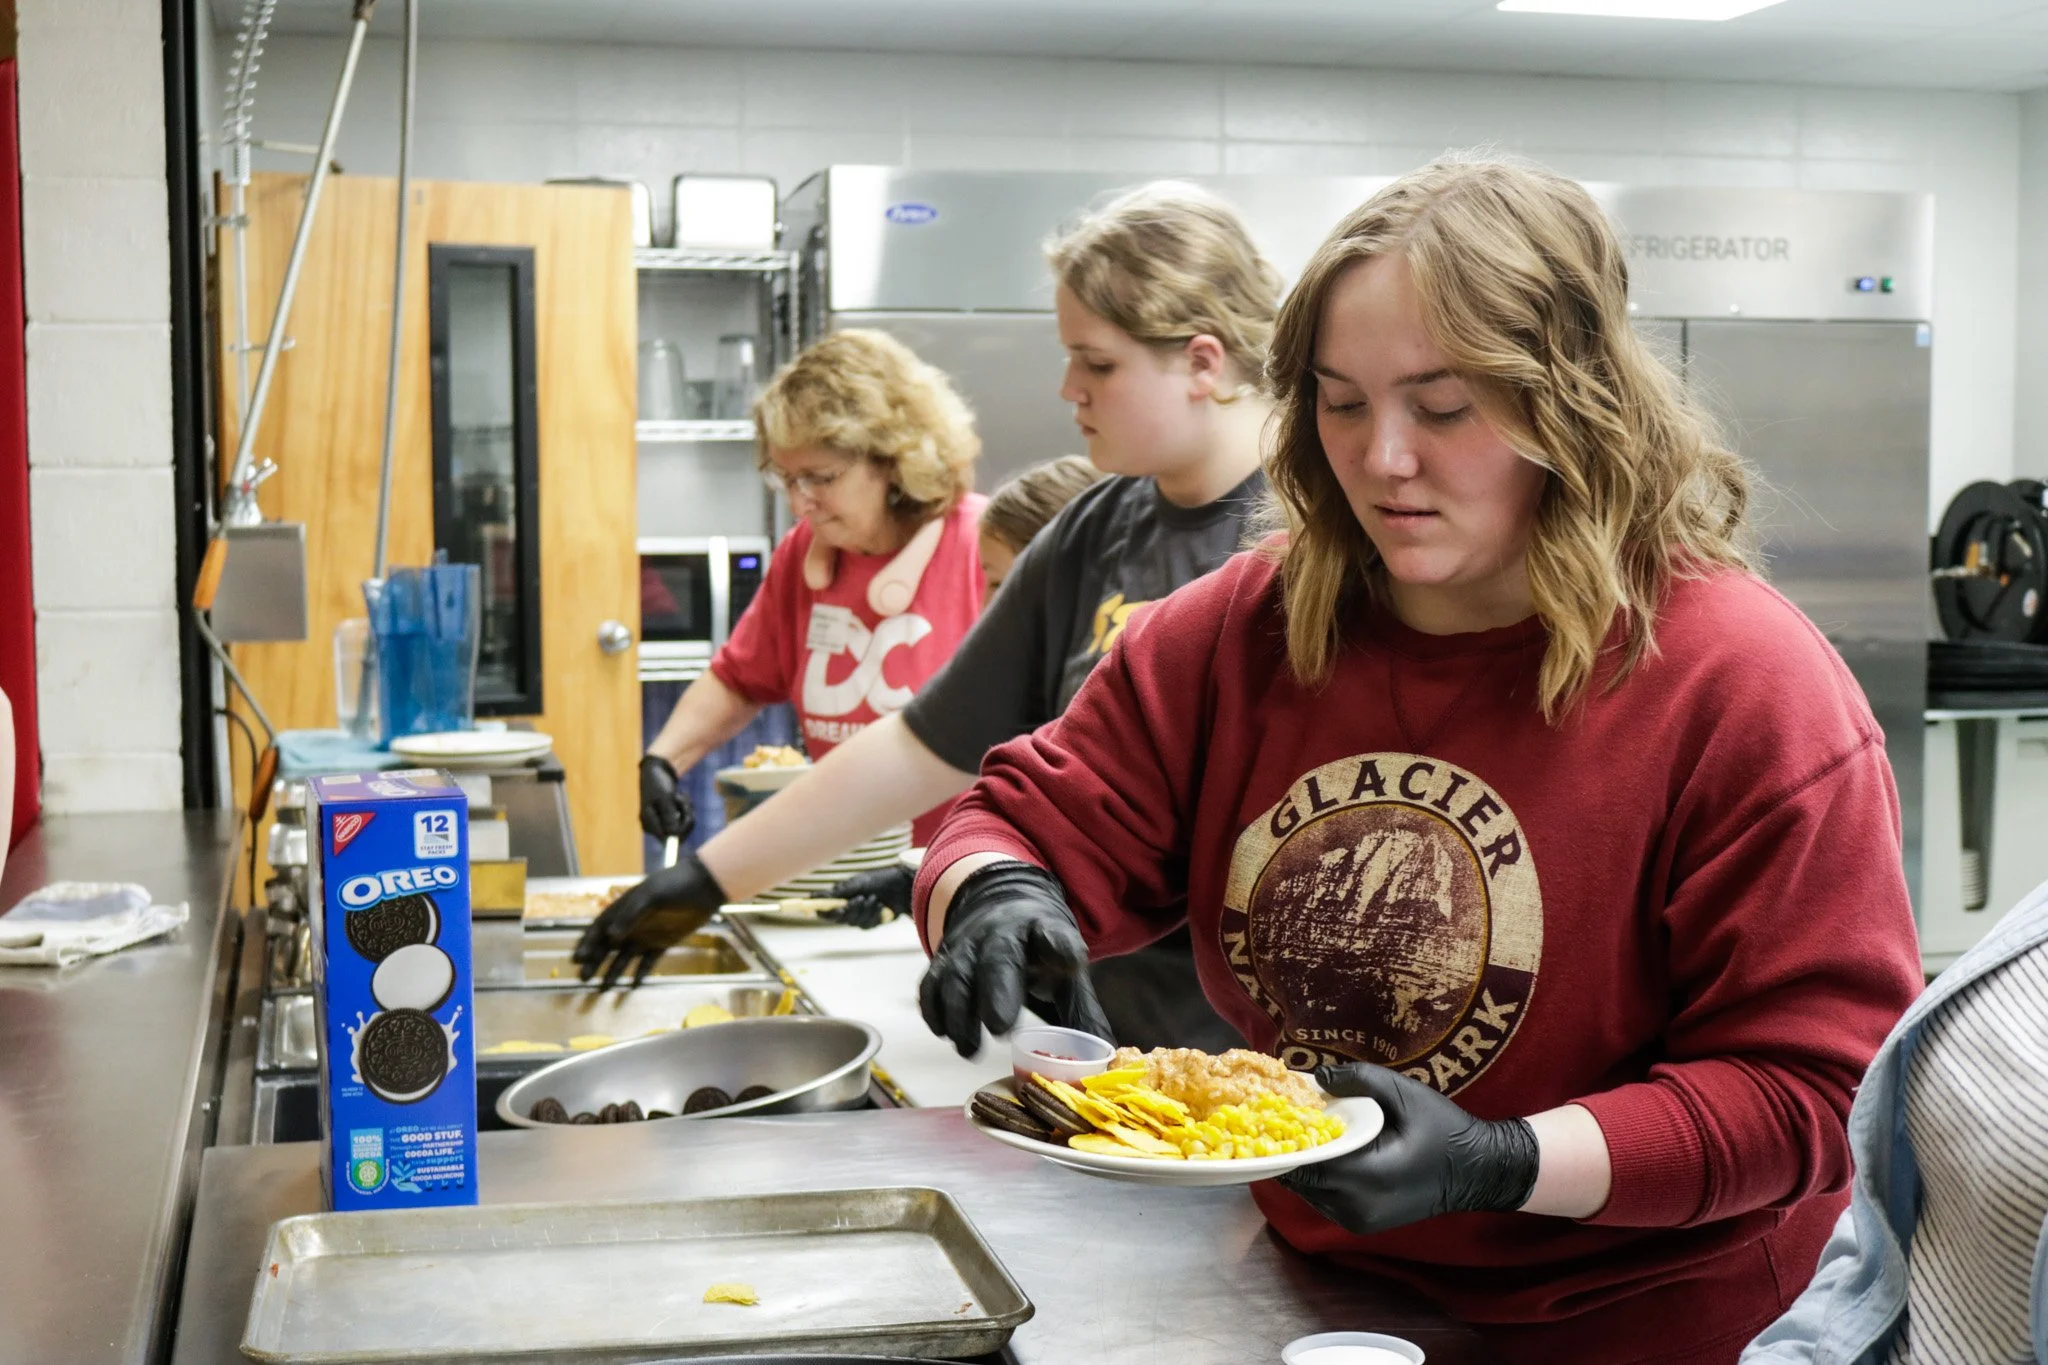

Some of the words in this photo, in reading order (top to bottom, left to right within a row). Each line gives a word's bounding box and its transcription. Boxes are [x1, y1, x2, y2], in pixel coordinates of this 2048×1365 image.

[1628, 234, 1791, 261] FRIGERATOR
[421, 815, 449, 833] 12
[1270, 759, 1522, 879] GLACIER
[341, 866, 457, 906] OREO
[1297, 1028, 1366, 1045] SINCE
[1372, 1036, 1398, 1061] 1910
[353, 1135, 382, 1144] 100%
[401, 1132, 432, 1143] GOOD
[434, 1130, 463, 1140] STUF.
[405, 1149, 433, 1158] COCOA
[417, 1164, 464, 1174] SUSTAINABLE
[410, 1174, 432, 1182] COCOA
